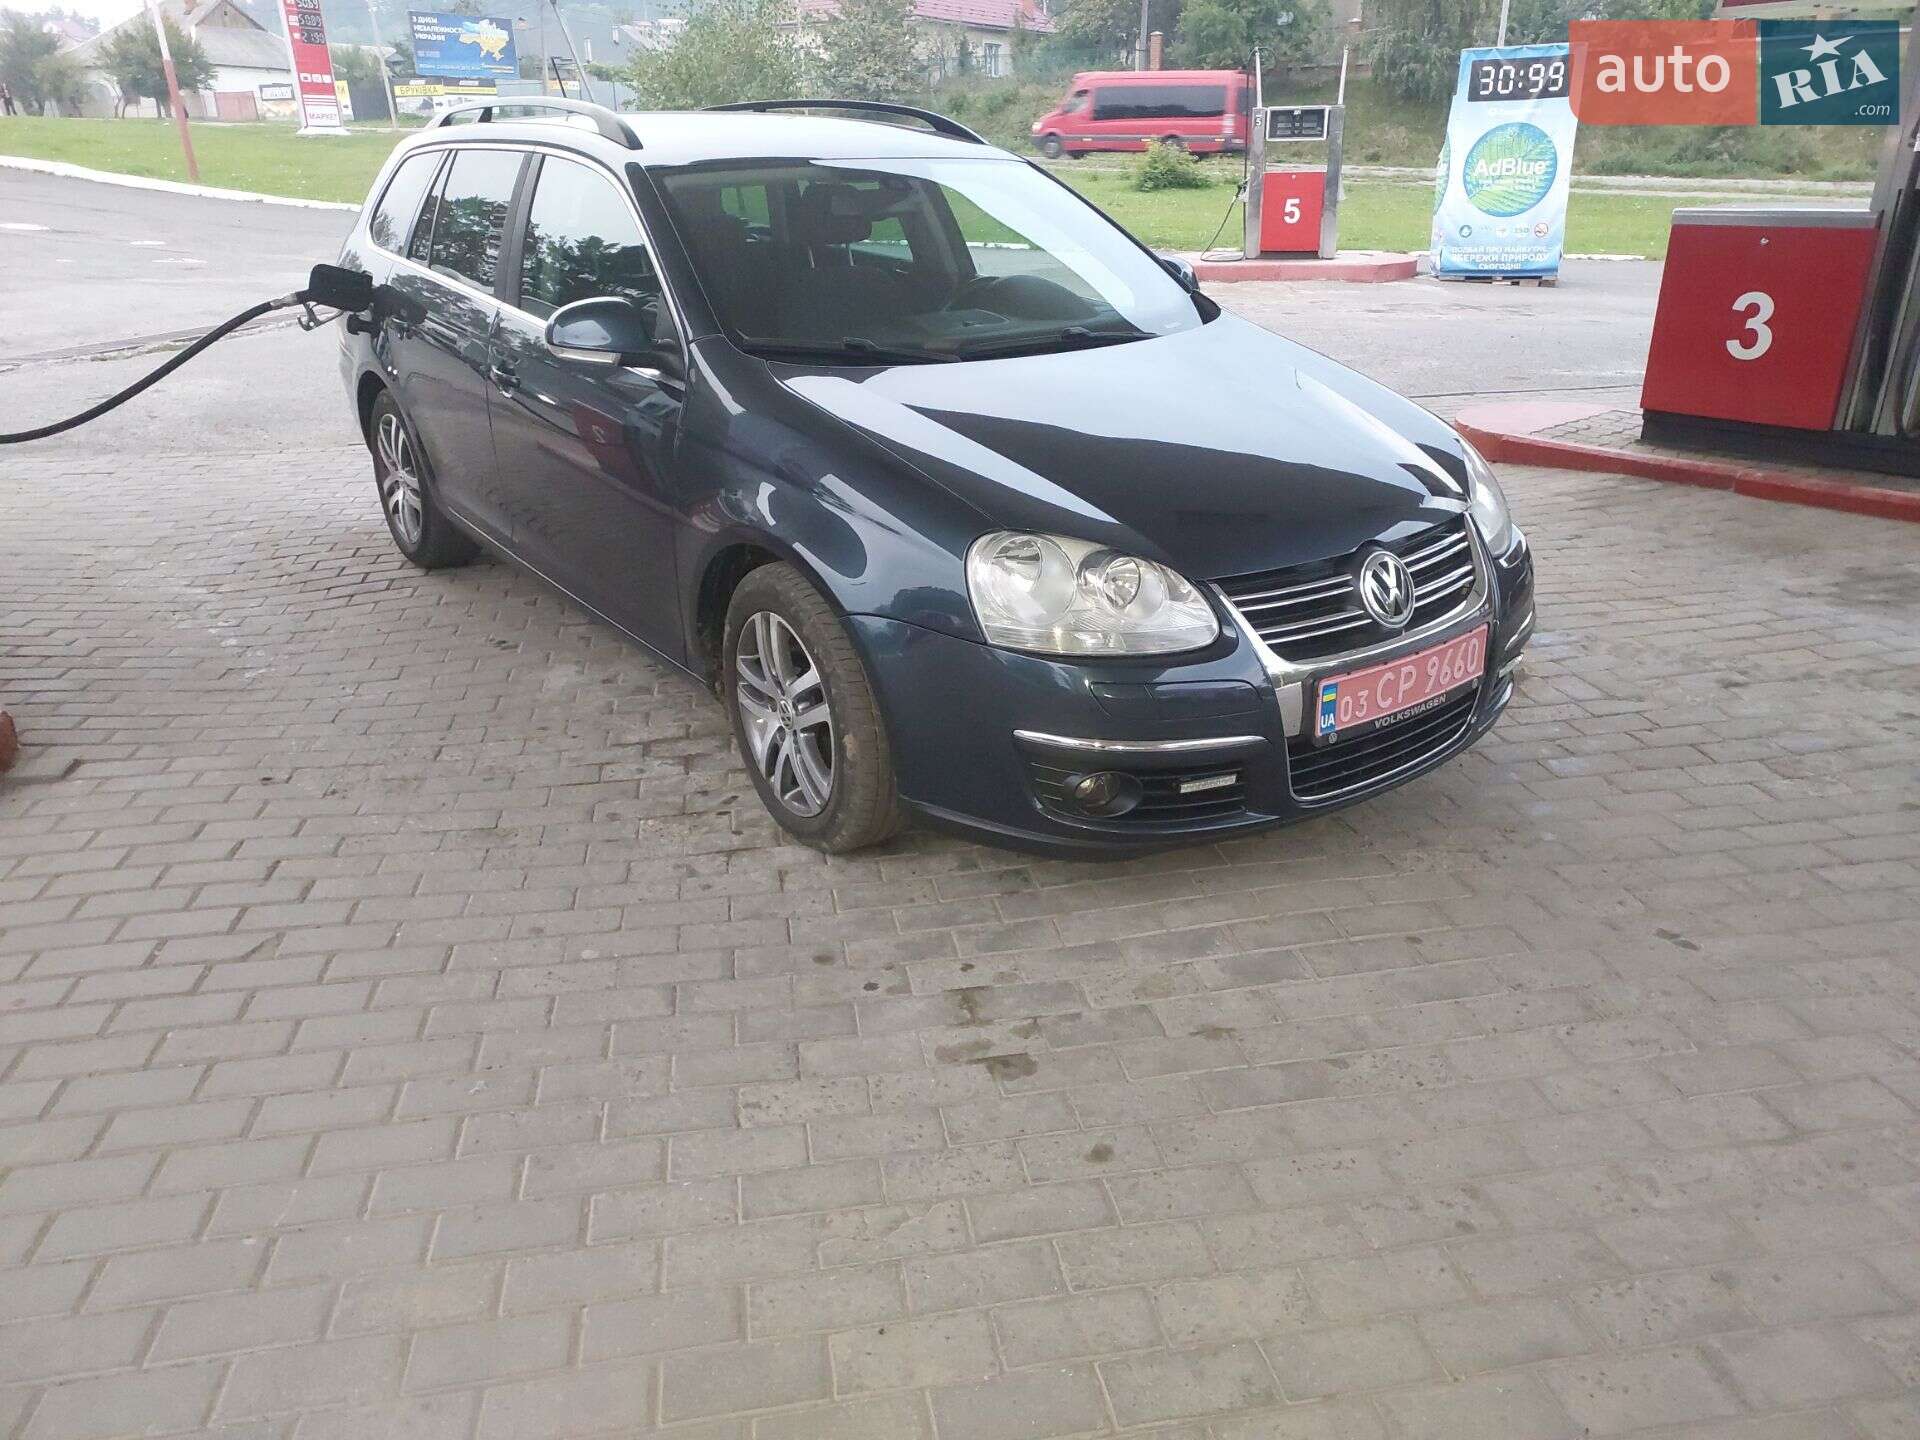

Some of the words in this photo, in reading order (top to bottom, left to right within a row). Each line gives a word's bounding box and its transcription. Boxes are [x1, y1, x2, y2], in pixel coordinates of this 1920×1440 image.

[1479, 61, 1566, 96] 30:99
[1255, 116, 1262, 126] 5
[1474, 157, 1549, 177] AdBlue
[1283, 198, 1301, 224] 5
[1501, 253, 1549, 262] ПРИРОДУ
[1725, 291, 1775, 361] 3
[1340, 689, 1369, 722] 03
[1424, 637, 1479, 693] 9660
[1320, 713, 1335, 728] UA
[1374, 694, 1447, 729] VOLKSWAGEN
